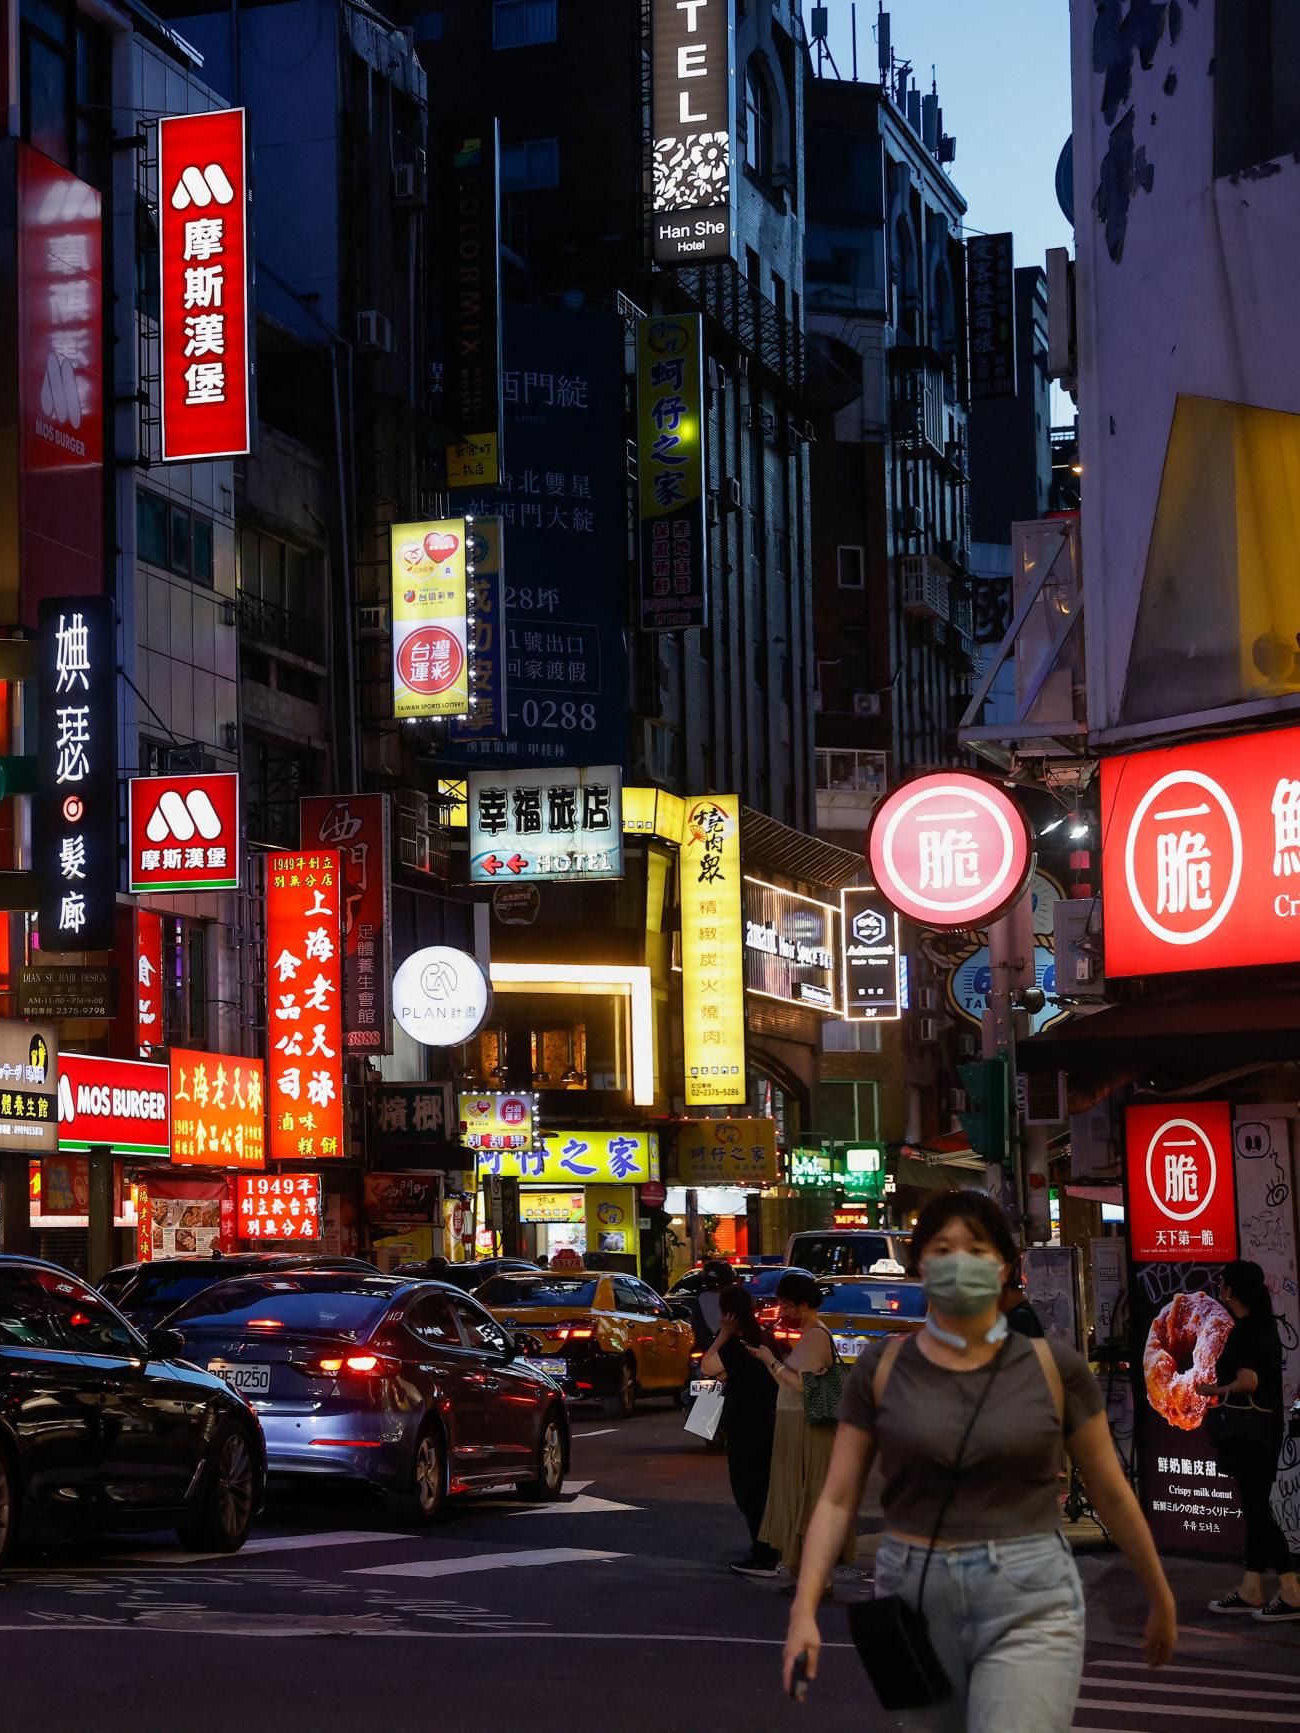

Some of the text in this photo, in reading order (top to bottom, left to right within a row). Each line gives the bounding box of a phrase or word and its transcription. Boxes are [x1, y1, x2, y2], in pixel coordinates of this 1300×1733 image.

[660, 220, 725, 239] Han She
[678, 240, 705, 252] Hotel
[184, 217, 225, 405] 摩斯漢堡
[35, 419, 86, 458] MOS BURGER
[411, 640, 451, 661] 台灣
[409, 661, 451, 682] 運彩
[479, 784, 612, 836] 幸福旅店
[141, 848, 227, 870] 摩斯漢堡
[915, 810, 981, 890] 一脆
[1154, 803, 1214, 915] 一脆
[535, 853, 613, 873] HOTEL
[59, 834, 86, 934] 髮廊
[402, 1007, 446, 1019] PLAN
[273, 949, 303, 1101] 食品公司
[77, 1085, 166, 1120] MOS BURGER
[277, 1112, 318, 1132] 滷味
[1162, 1139, 1199, 1202] 一脆
[246, 1179, 314, 1195] 1949年
[1156, 1230, 1214, 1246] 天下第一脆
[1168, 1485, 1233, 1500] Crispy milk donut
[1183, 1520, 1197, 1531] 우유
